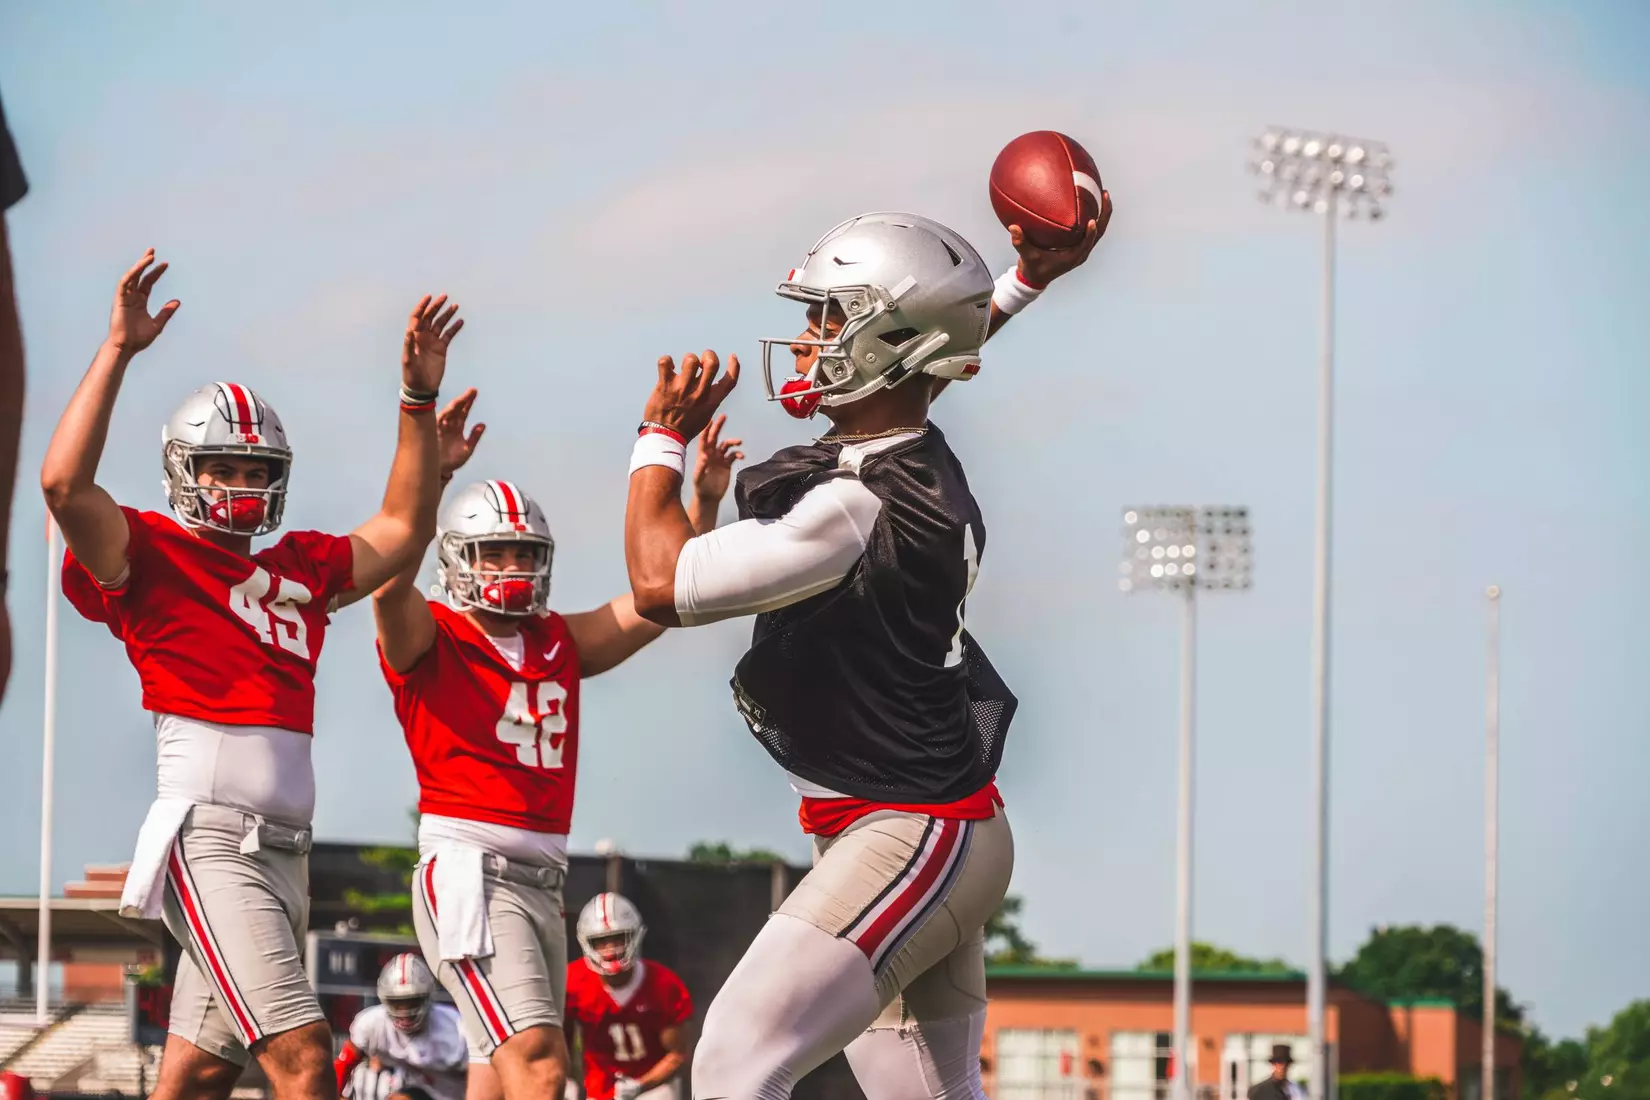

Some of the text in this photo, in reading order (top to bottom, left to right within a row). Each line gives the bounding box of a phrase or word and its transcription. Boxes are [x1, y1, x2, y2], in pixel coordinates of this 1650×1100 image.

[229, 565, 313, 660] 45
[495, 681, 568, 769] 42
[753, 707, 761, 720] XL
[608, 1022, 647, 1061] 11
